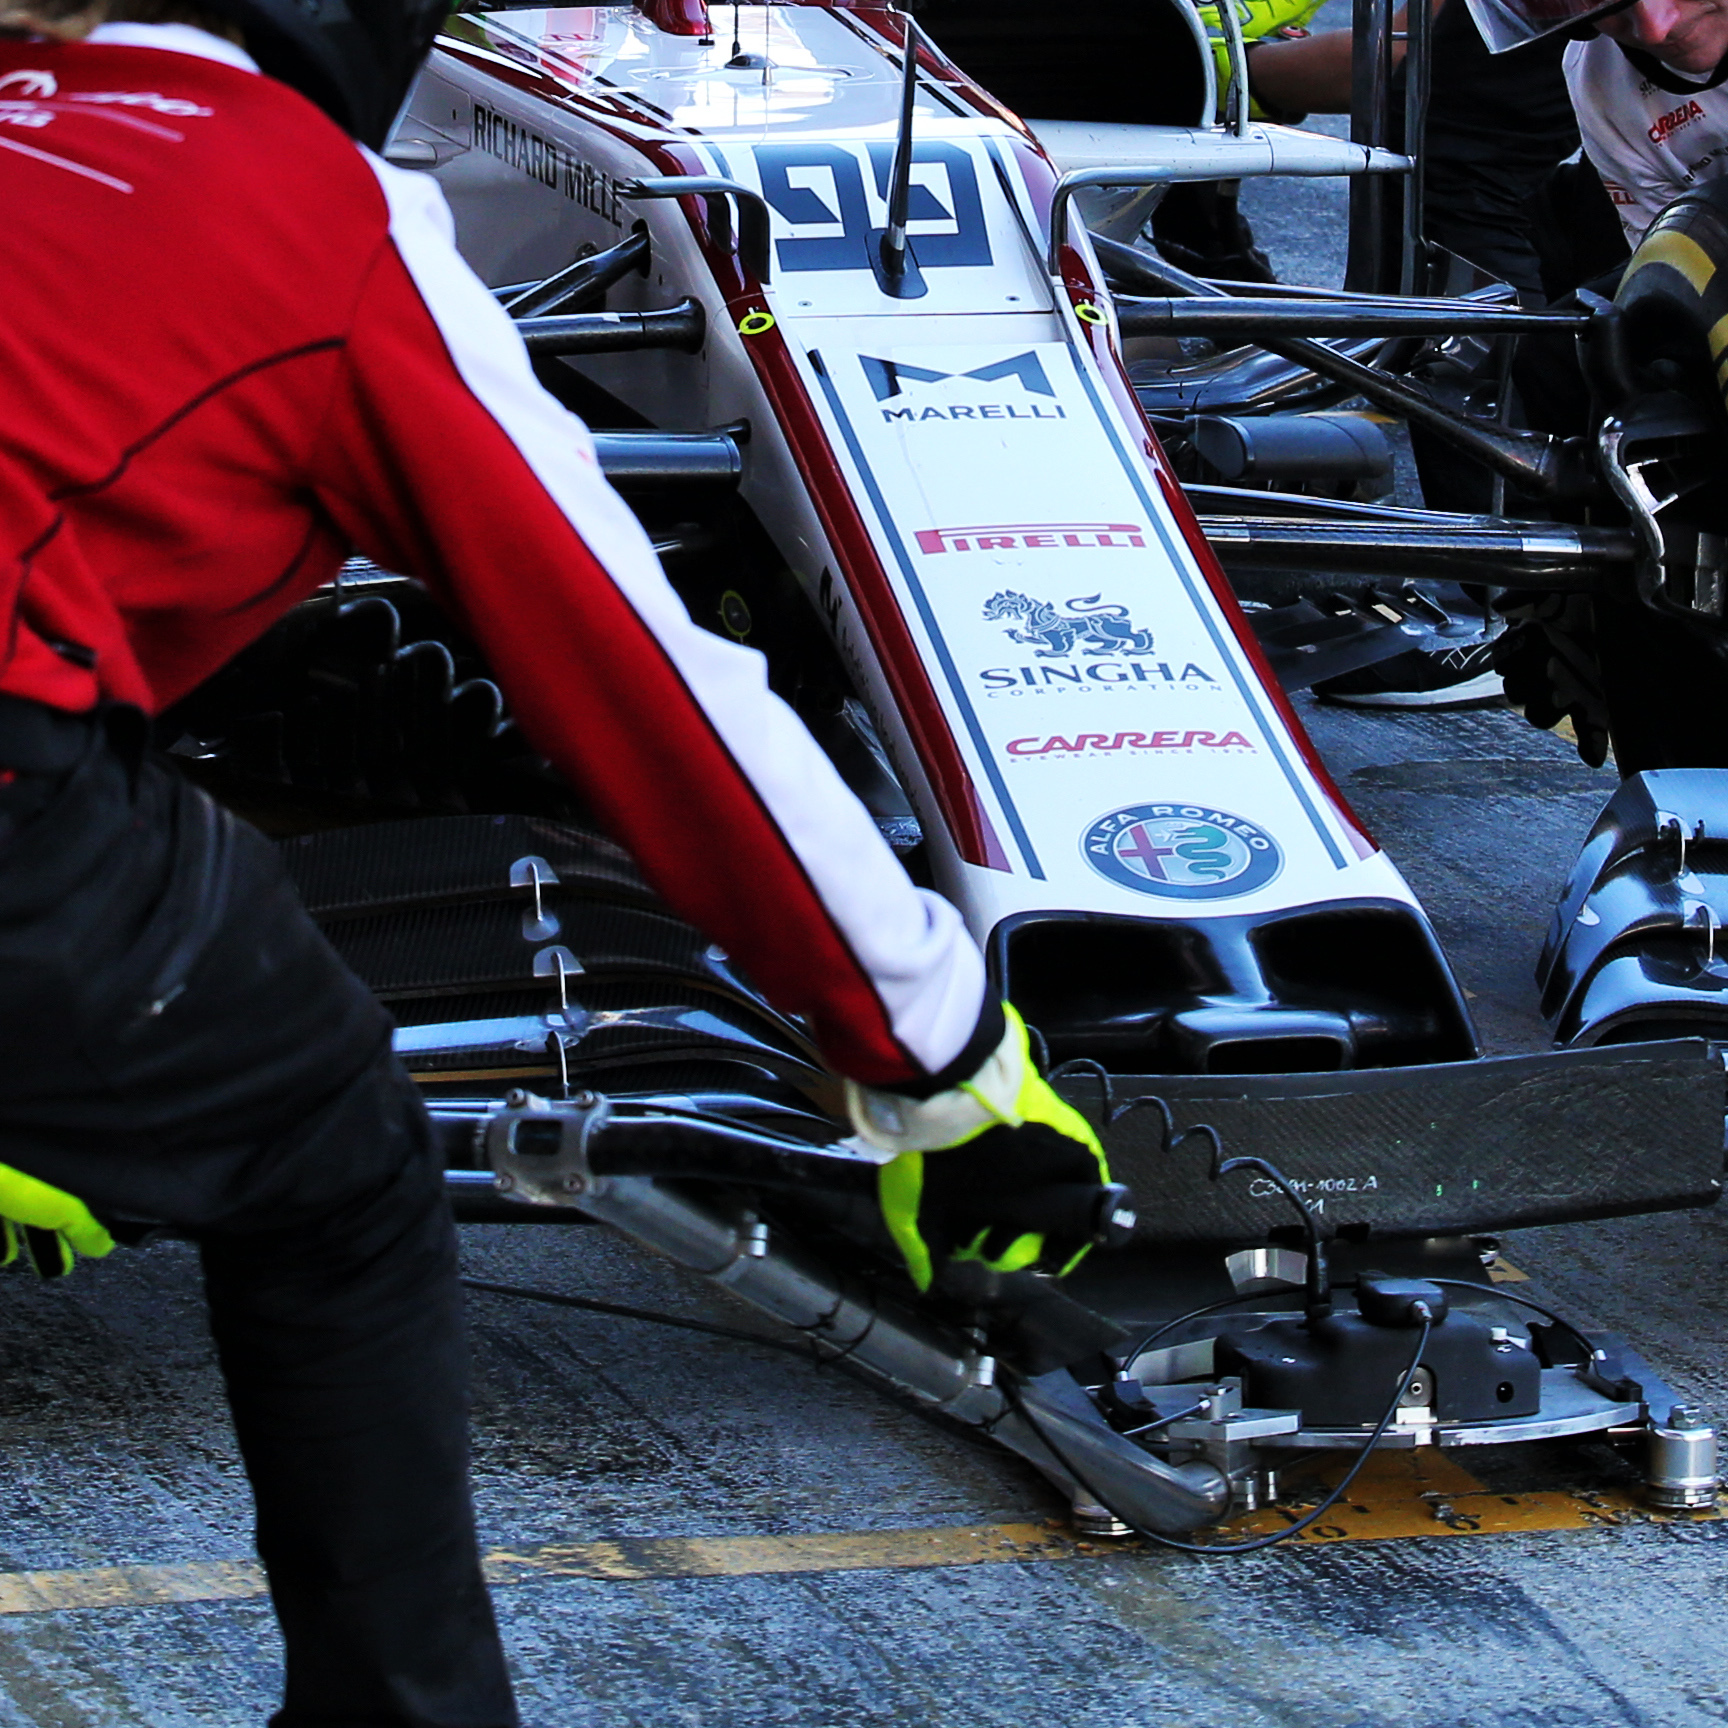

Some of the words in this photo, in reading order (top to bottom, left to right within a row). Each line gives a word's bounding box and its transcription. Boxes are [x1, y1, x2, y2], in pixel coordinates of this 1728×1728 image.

[474, 103, 557, 189] RICHARD
[565, 153, 622, 228] MILLE
[750, 142, 996, 272] 99
[881, 403, 1067, 424] MARELLI
[915, 523, 1146, 555] PIRELLI
[979, 662, 1217, 689] SINGHA
[987, 685, 1222, 699] CORPORATION
[1006, 731, 1254, 756] CARRERA
[1090, 813, 1139, 856] ALFA
[1151, 806, 1270, 852] ROMEO
[1362, 1175, 1378, 1189] A
